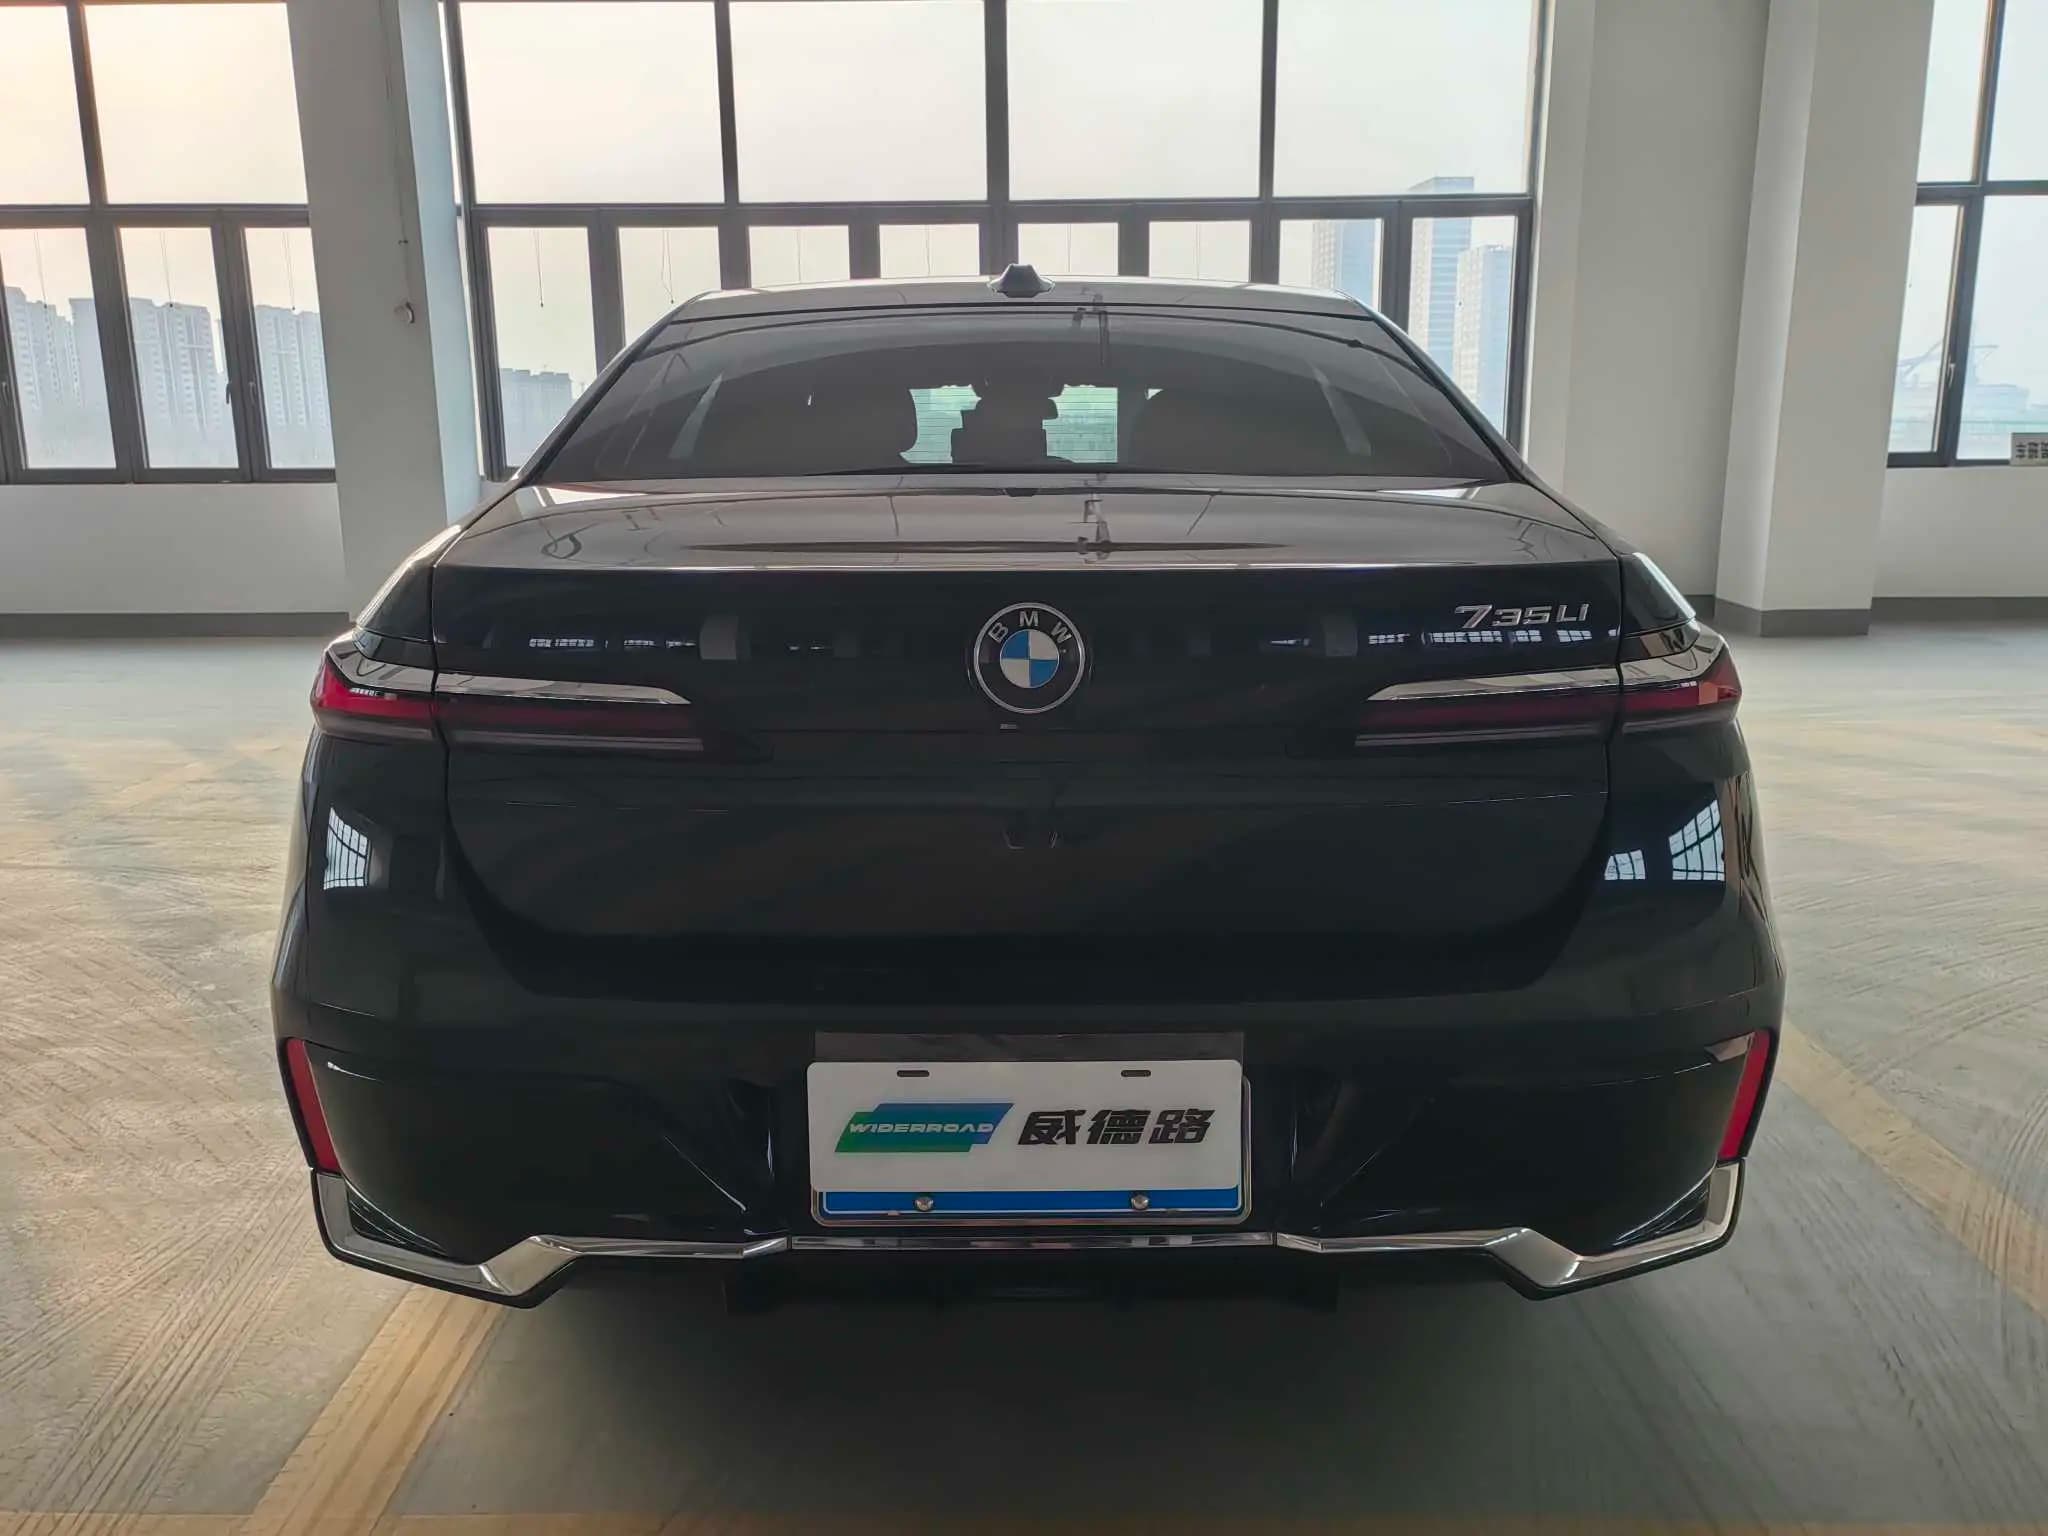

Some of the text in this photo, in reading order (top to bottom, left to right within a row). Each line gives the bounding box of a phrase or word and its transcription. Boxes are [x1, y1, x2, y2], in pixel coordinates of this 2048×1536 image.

[987, 610, 1072, 644] BMW
[850, 1123, 994, 1133] WIDERROAD
[1017, 1108, 1216, 1145] 威德路
